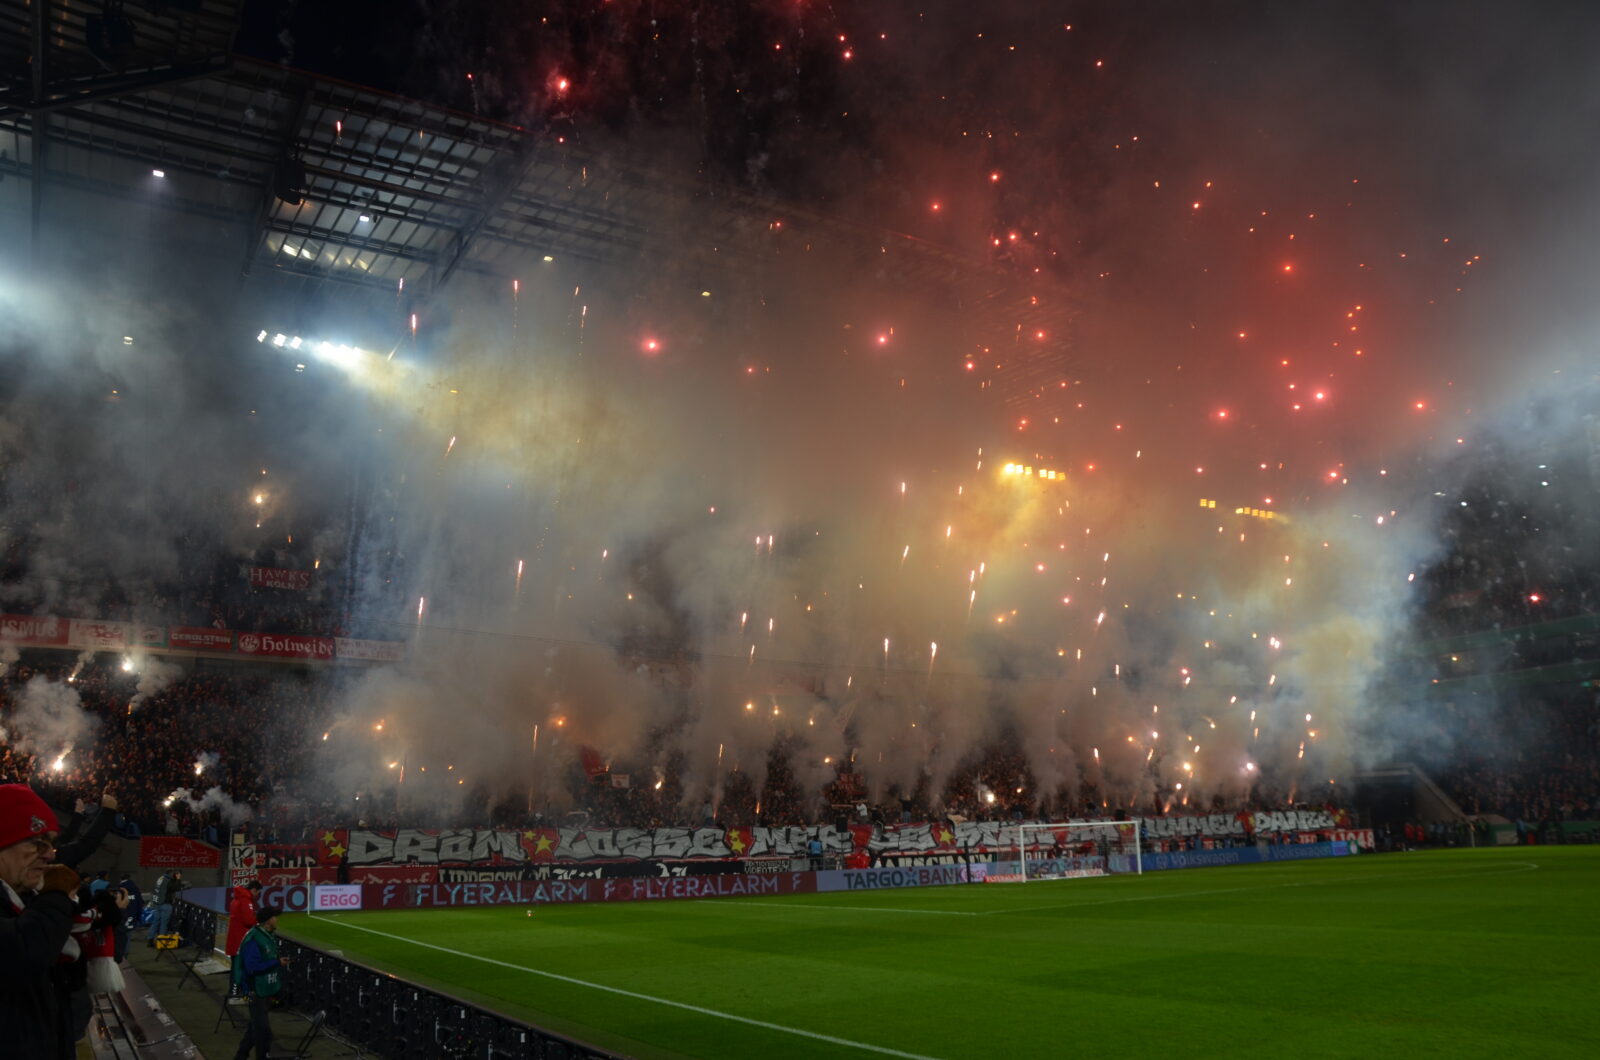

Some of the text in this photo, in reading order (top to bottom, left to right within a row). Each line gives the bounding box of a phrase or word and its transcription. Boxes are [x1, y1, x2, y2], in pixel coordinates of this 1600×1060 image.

[1171, 851, 1240, 867] Volkswagen
[632, 875, 780, 900] FLYERALARM
[843, 868, 904, 889] TARGO
[320, 894, 360, 907] ERGO
[416, 881, 588, 906] FLYERALARM
